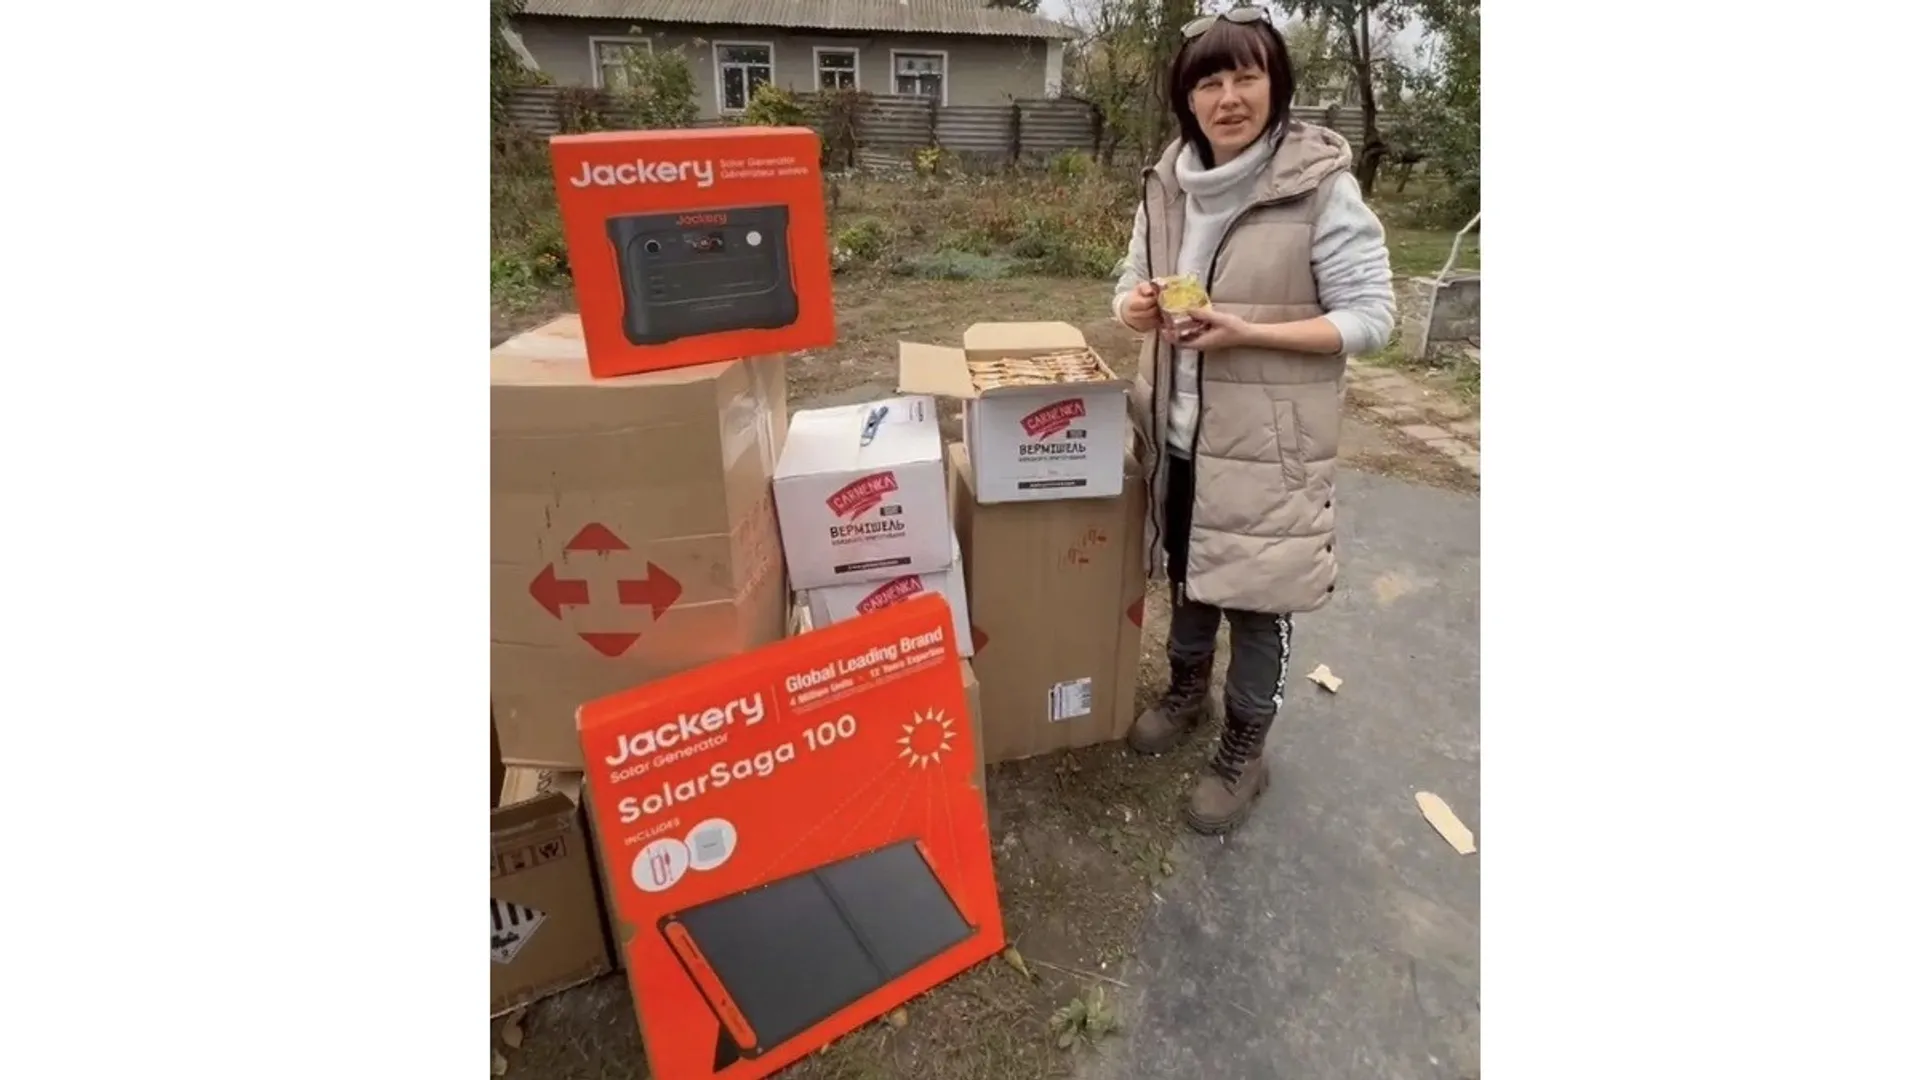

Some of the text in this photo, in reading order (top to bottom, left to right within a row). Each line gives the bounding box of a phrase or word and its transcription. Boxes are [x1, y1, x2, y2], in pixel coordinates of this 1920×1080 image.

[570, 158, 714, 188] Jackery
[676, 213, 728, 226] Jackery
[829, 519, 906, 538] ВЕРМІШЕЛЬ
[785, 662, 836, 693] Global
[837, 643, 898, 675] Leading
[900, 625, 944, 653] Brand
[605, 691, 765, 766] Jackery
[609, 732, 729, 784] Solar Generator
[617, 713, 857, 823] SolarSaga 100
[624, 816, 681, 846] INCLUDES
